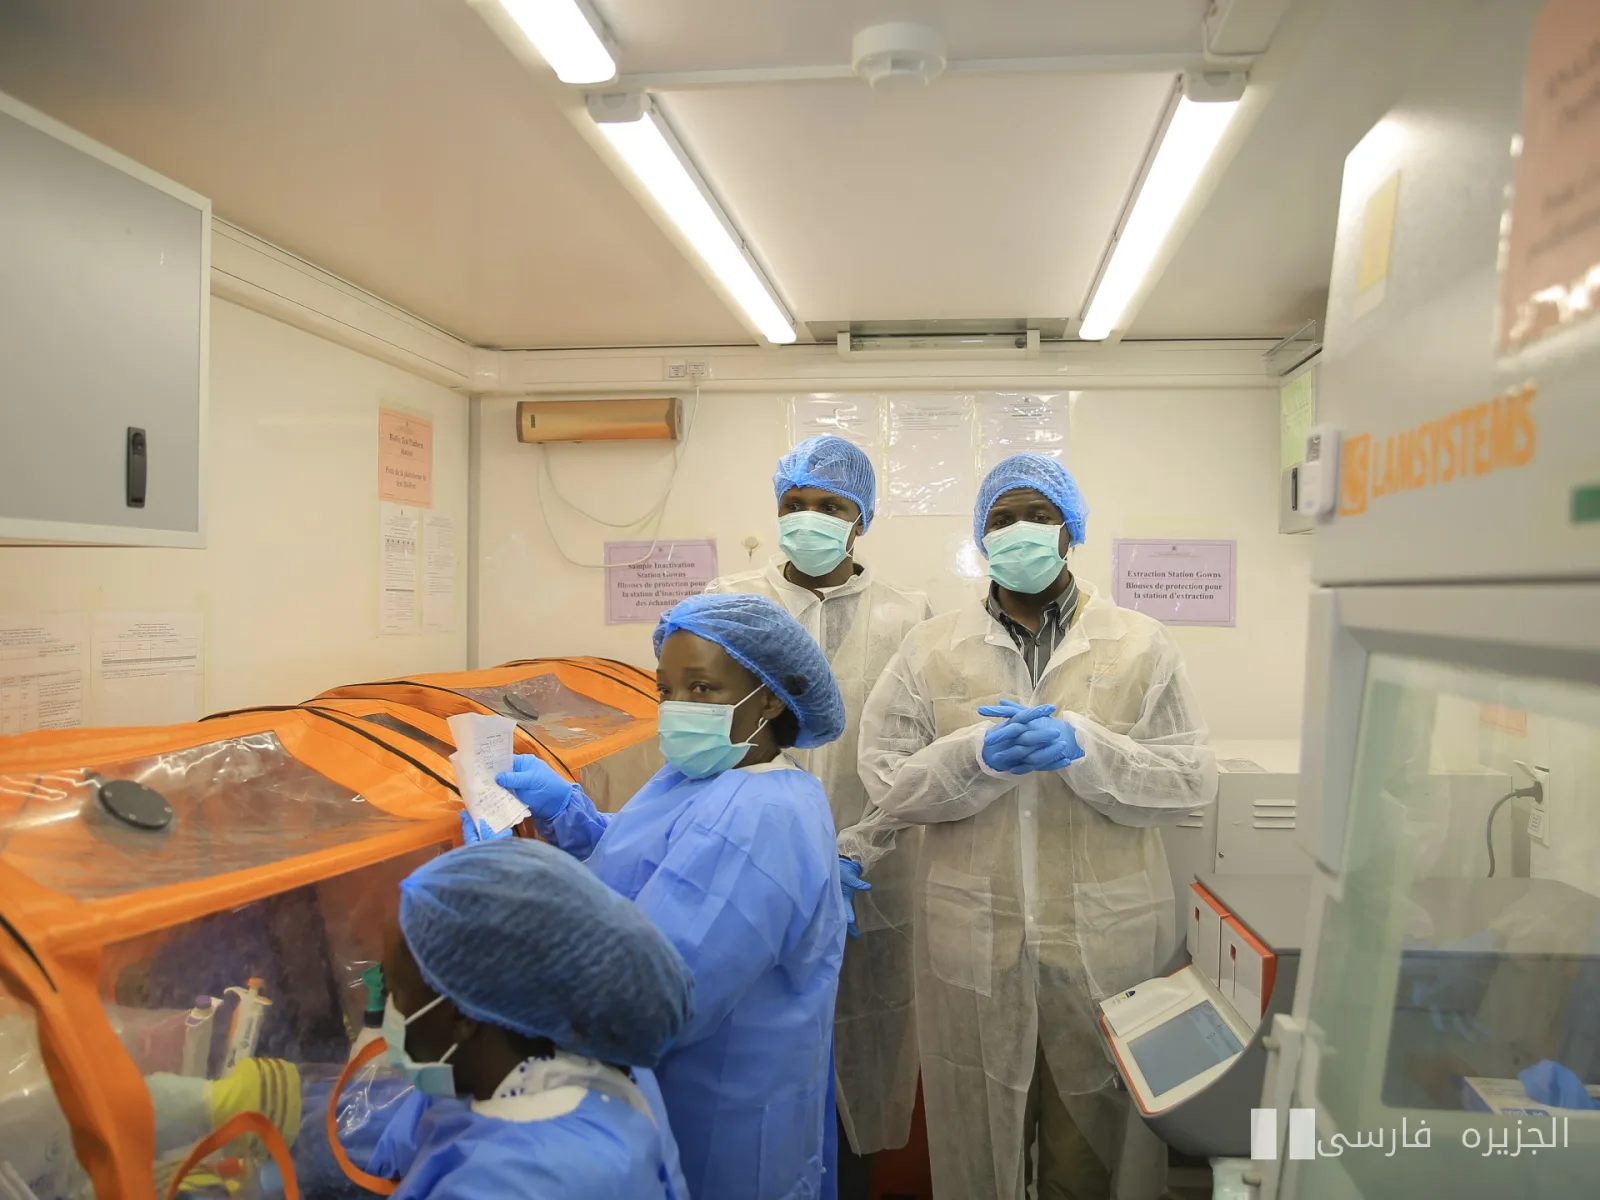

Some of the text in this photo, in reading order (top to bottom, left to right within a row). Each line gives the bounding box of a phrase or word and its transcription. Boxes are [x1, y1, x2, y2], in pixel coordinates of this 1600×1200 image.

[628, 561, 695, 571] Sample Inactivation
[636, 571, 687, 579] Station Gowns
[1127, 570, 1222, 578] Extraction Station Gowns
[617, 580, 707, 590] Blouses de protection pour
[1125, 582, 1223, 592] Blouses de protection pour
[630, 590, 653, 598] station
[1134, 591, 1214, 600] la station d'extraction
[635, 599, 647, 607] des
